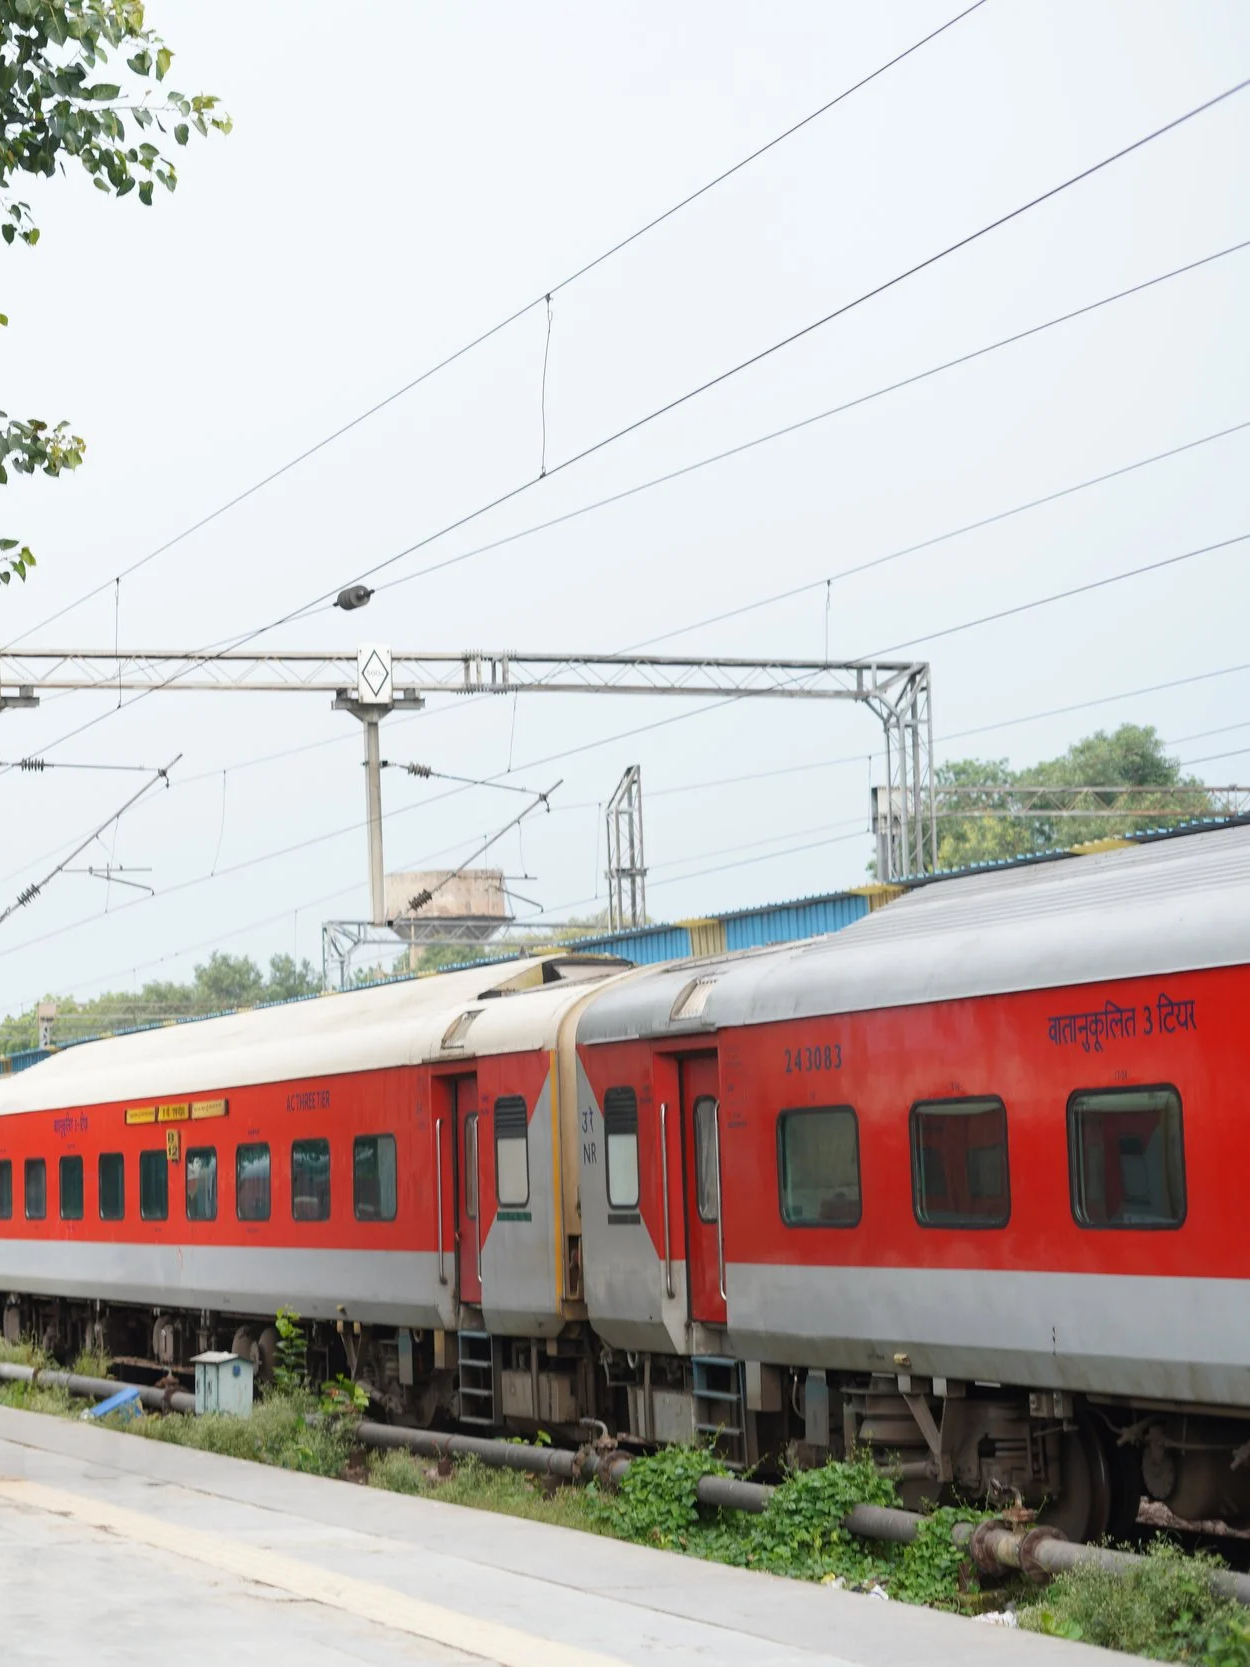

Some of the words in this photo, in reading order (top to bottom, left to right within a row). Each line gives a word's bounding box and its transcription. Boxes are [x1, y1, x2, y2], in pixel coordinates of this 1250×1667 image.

[1048, 1000, 1136, 1052] वातानुकूलित
[1143, 1006, 1153, 1035] 3
[1156, 992, 1197, 1034] टियर
[784, 1043, 842, 1073] 243083
[583, 1142, 597, 1164] NR
